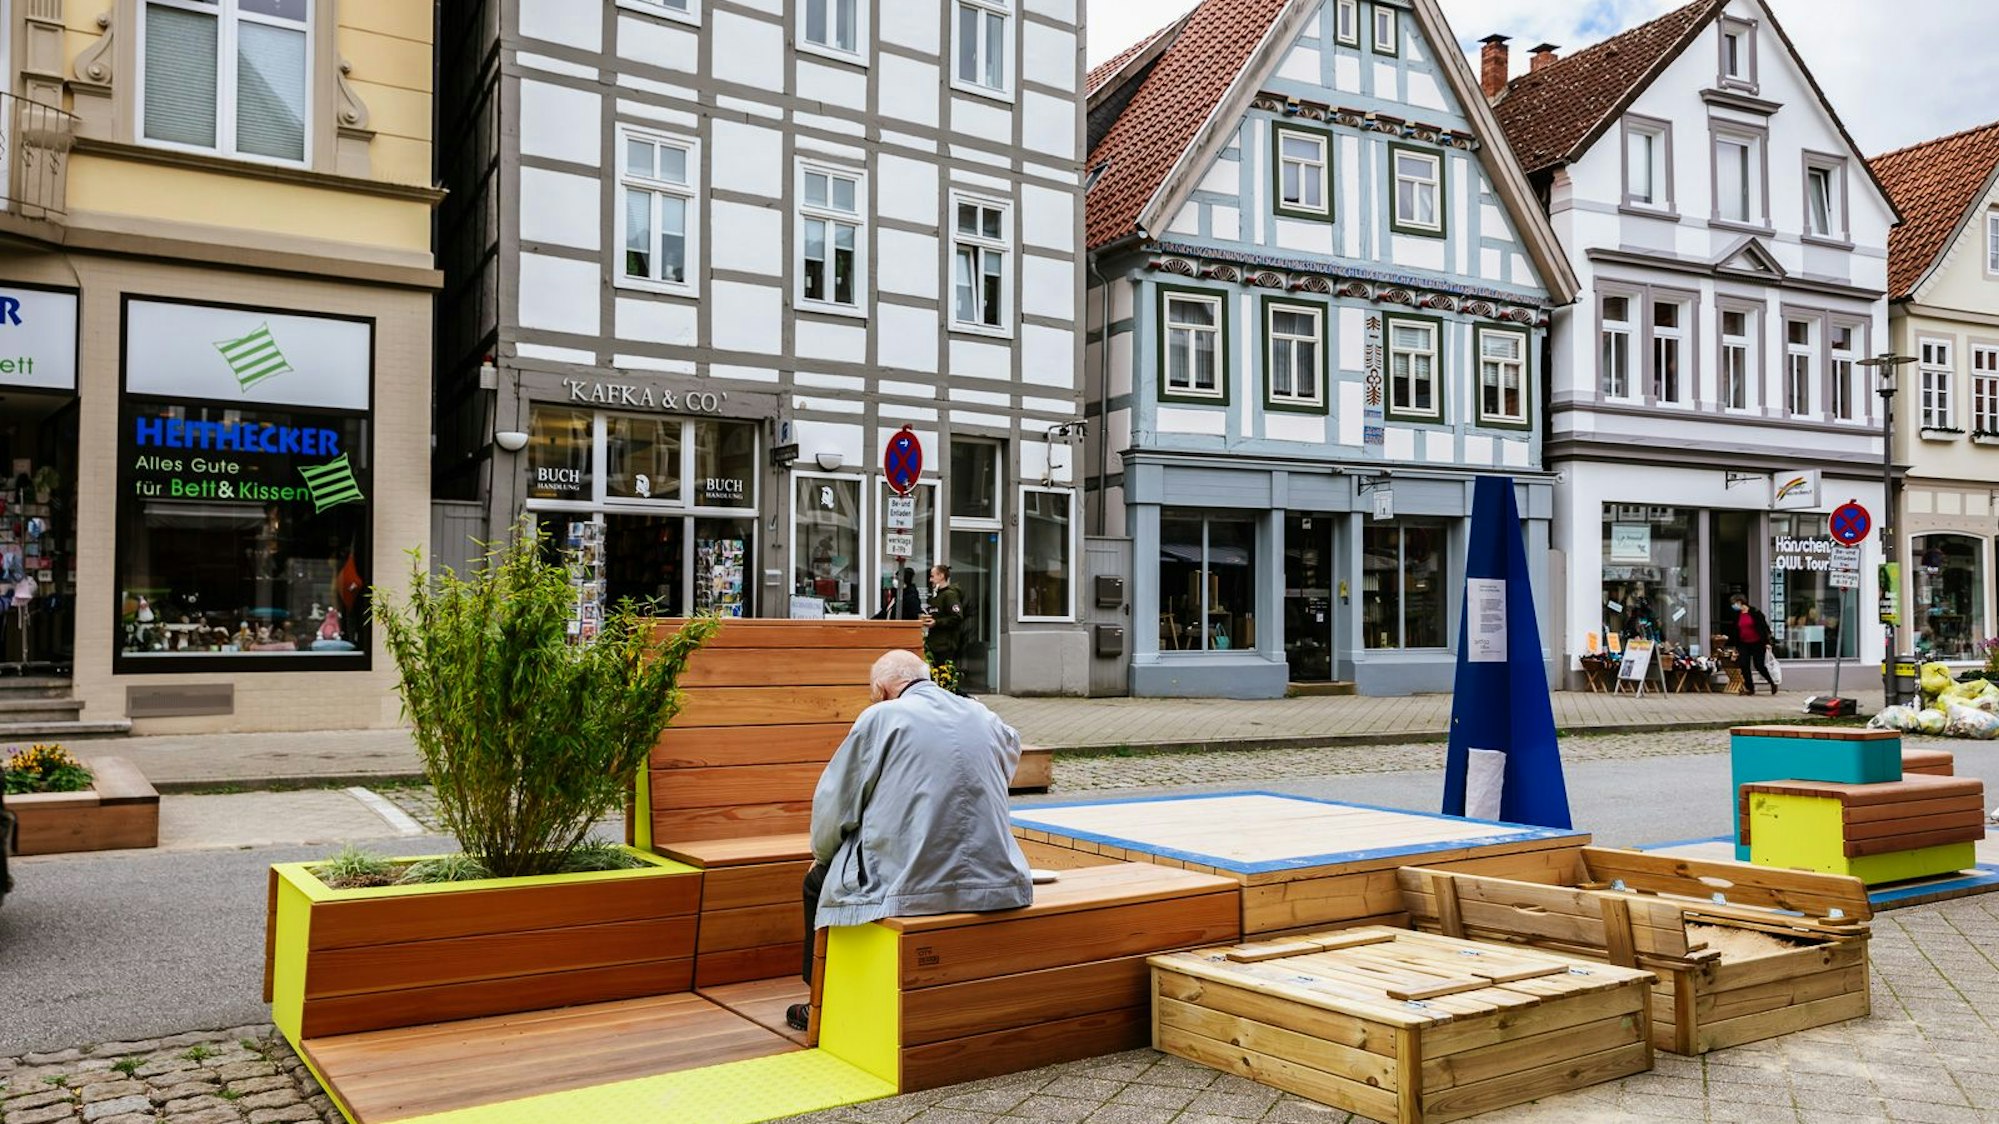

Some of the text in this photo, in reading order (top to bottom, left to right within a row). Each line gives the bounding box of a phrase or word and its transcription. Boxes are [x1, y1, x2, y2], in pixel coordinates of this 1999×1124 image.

[661, 389, 679, 409] &
[135, 455, 240, 474] Alles Gute
[538, 467, 580, 483] BUCH
[136, 480, 162, 496] für
[239, 481, 309, 501] Kissen
[537, 482, 580, 491] HANDLUNG
[706, 478, 743, 492] BUCH
[1775, 555, 1803, 570] OWL
